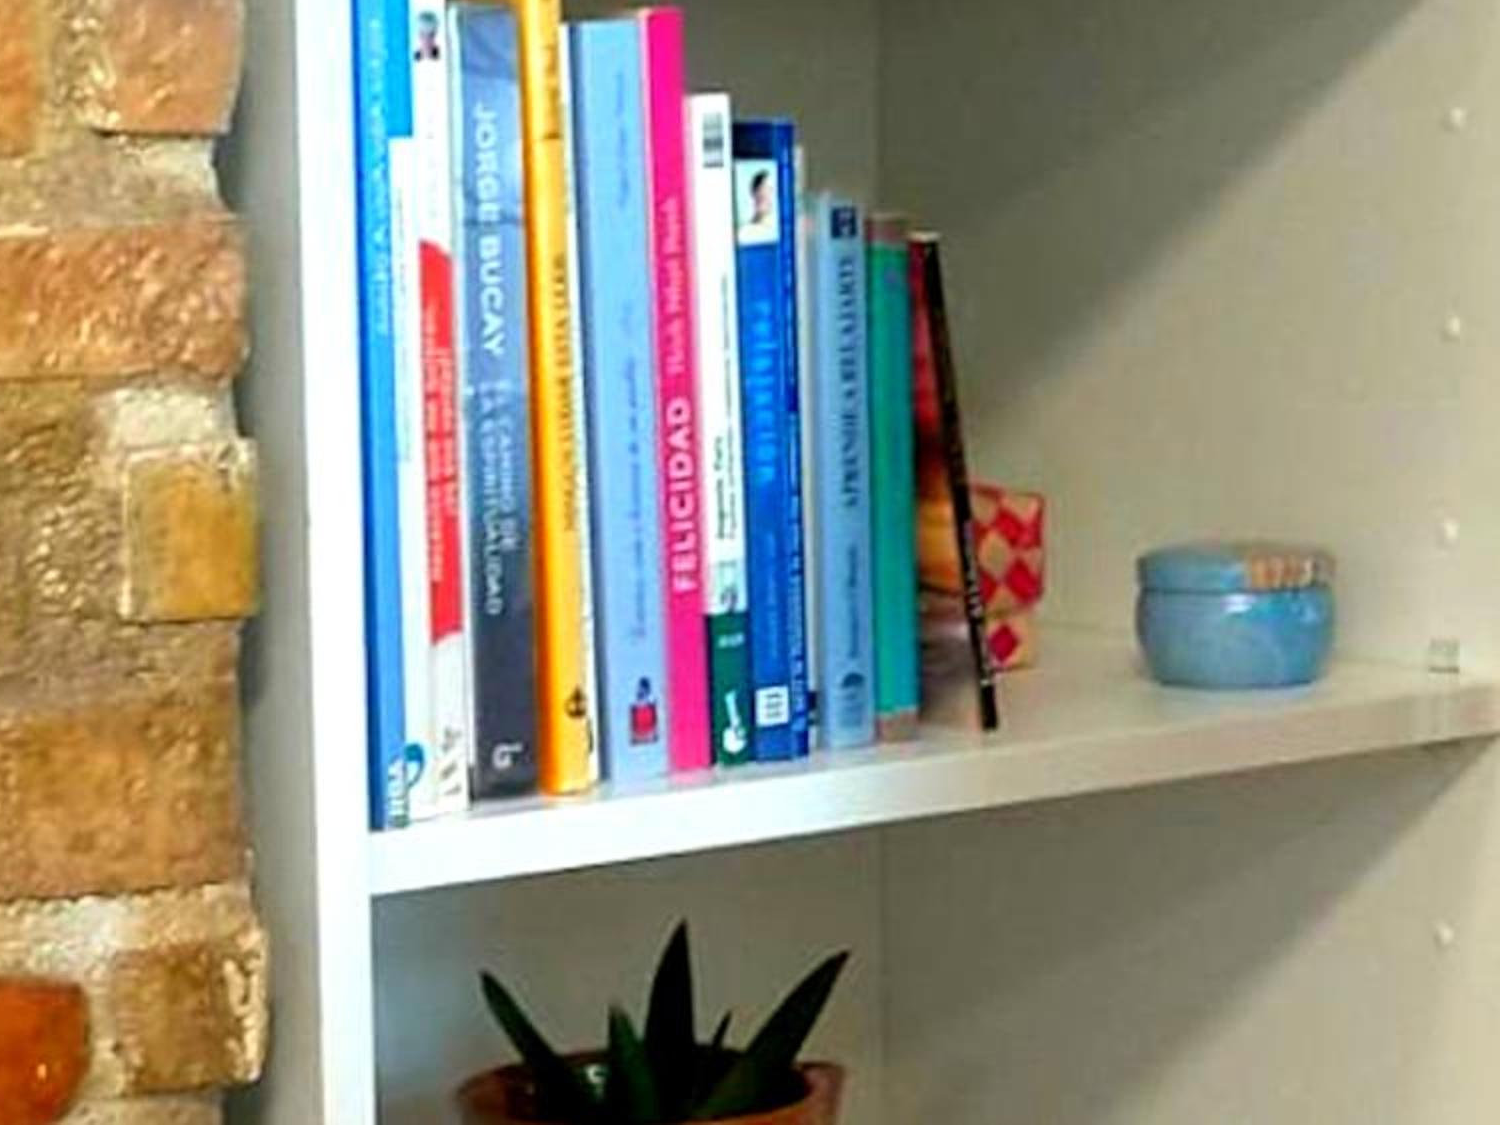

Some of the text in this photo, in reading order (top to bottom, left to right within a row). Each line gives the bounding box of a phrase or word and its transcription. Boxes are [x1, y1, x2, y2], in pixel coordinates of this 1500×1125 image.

[473, 101, 507, 357] JORGE BUCAY
[481, 418, 503, 615] ESPIRITUALIDAD
[667, 398, 702, 595] FELICIDAD
